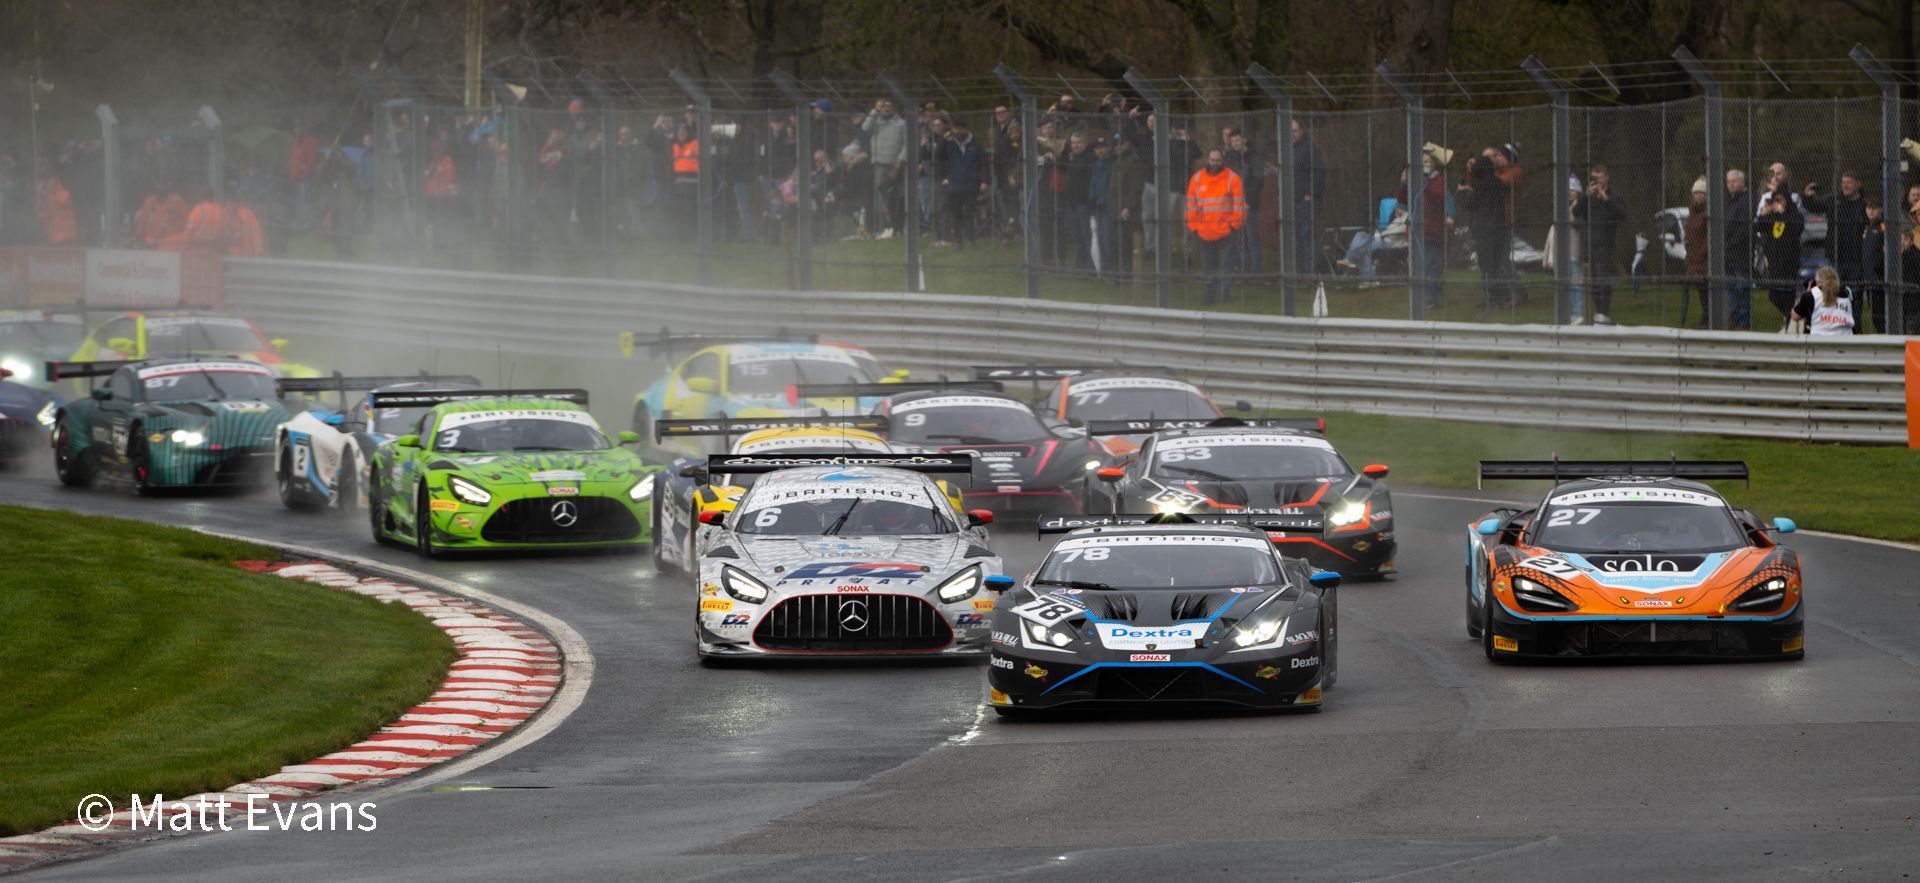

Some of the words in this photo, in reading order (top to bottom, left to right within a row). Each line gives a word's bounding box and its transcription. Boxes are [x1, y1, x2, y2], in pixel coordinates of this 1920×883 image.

[1819, 314, 1848, 326] MEDIA
[738, 364, 770, 376] 15
[1074, 391, 1111, 405] 77
[904, 413, 927, 427] 9
[439, 429, 461, 448] 3
[1159, 447, 1212, 462] 63
[773, 487, 919, 501] #BRITISHGT
[1561, 491, 1711, 501] #BRITISHGT
[754, 507, 782, 527] 6
[1547, 508, 1602, 527] 27
[1082, 535, 1243, 544] #BRITISHGT
[1058, 547, 1111, 563] 78
[1526, 557, 1578, 574] 27
[1604, 554, 1679, 572] solo
[776, 578, 918, 587] PRIVAT
[1024, 597, 1074, 620] 78
[1111, 628, 1192, 637] Dextra
[1290, 655, 1319, 669] Dextra
